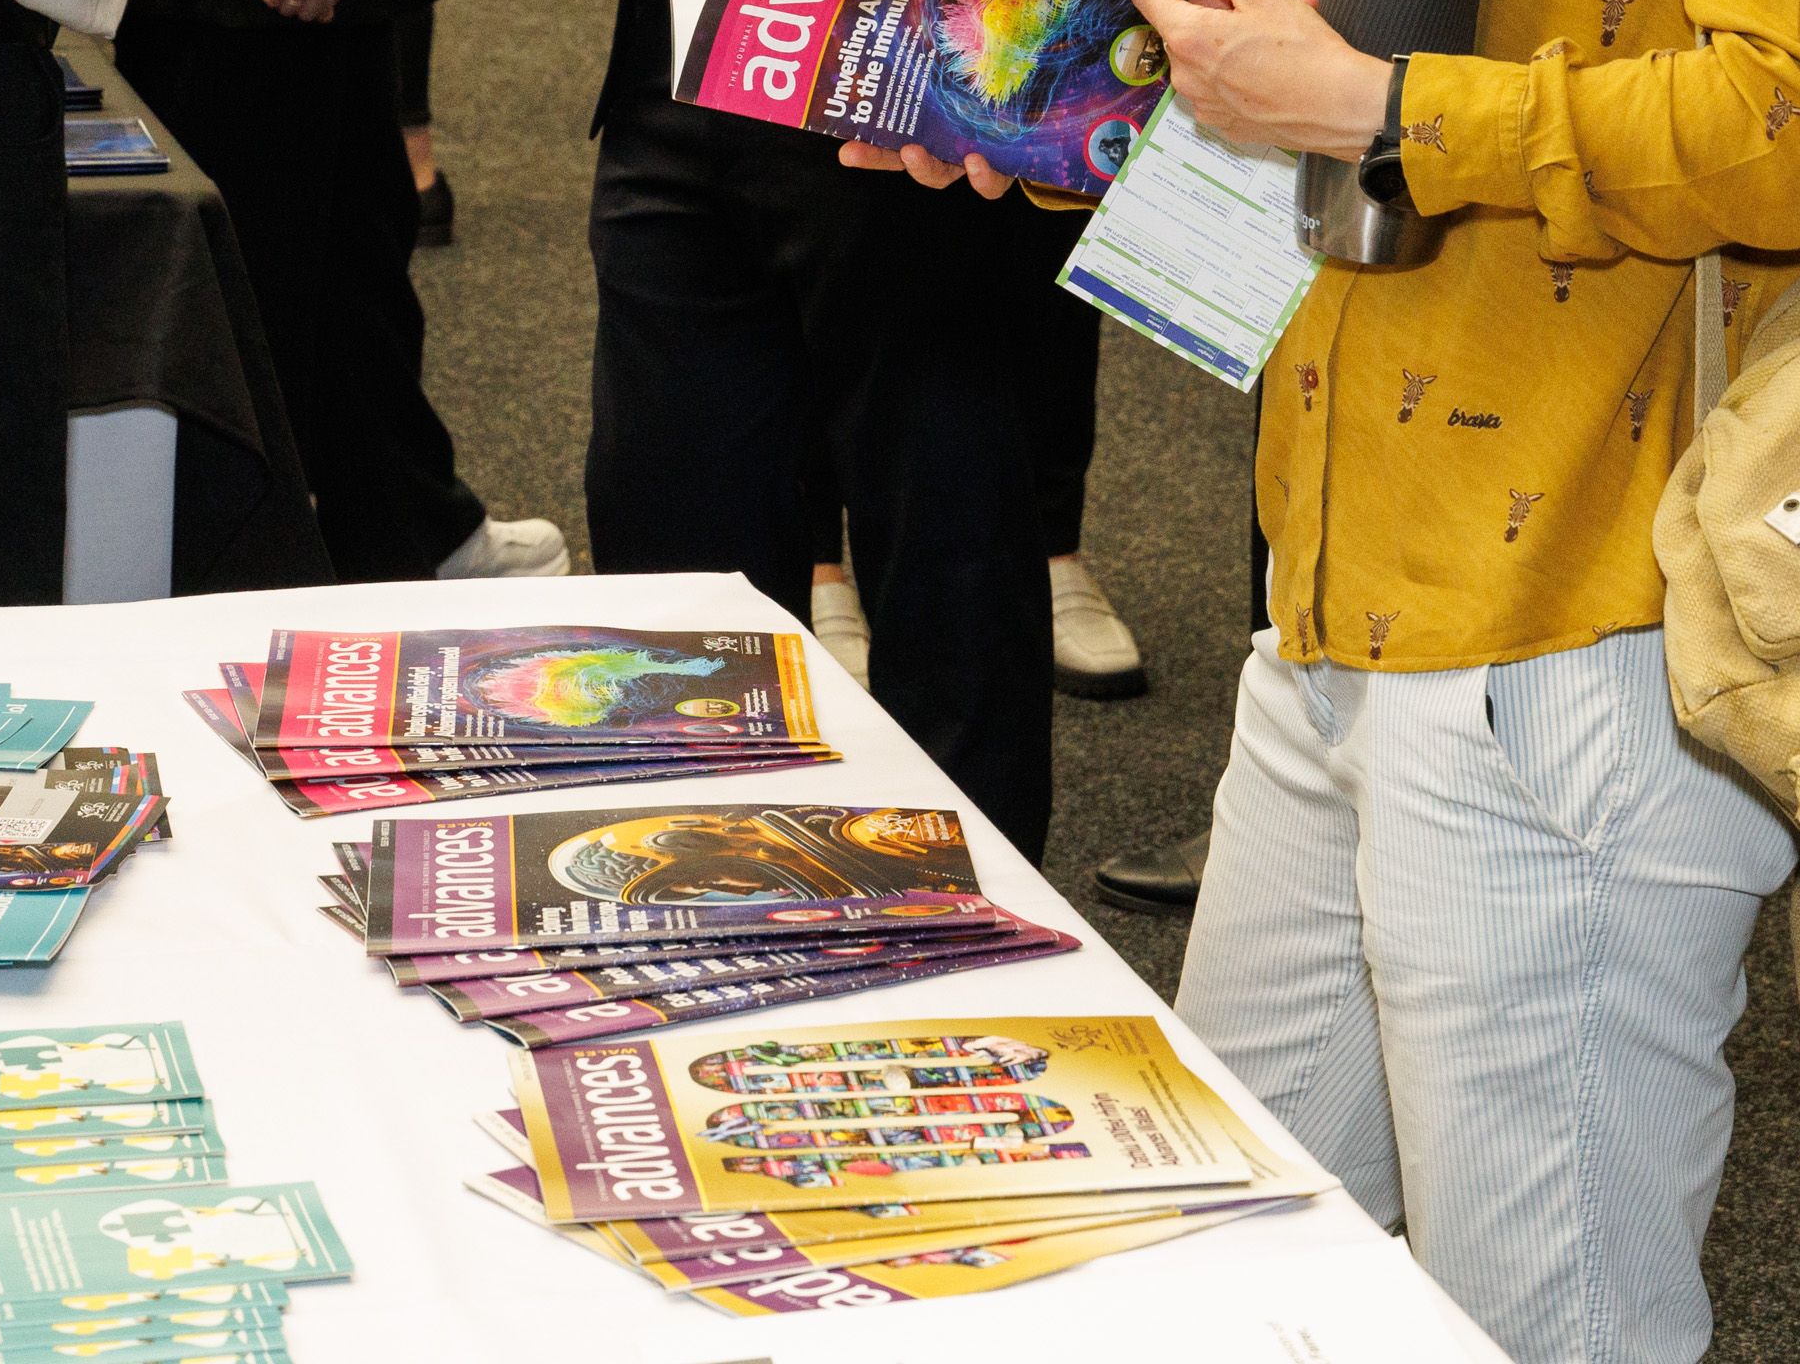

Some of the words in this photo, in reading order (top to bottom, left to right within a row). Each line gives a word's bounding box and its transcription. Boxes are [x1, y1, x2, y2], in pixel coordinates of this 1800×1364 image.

[899, 24, 912, 47] genetic
[916, 23, 923, 33] an
[728, 69, 738, 88] THE
[736, 24, 752, 66] JOURNAL
[890, 55, 901, 75] reveal
[896, 45, 904, 56] the
[902, 38, 918, 68] contribute
[824, 15, 876, 117] Unveiling
[853, 57, 885, 100] the
[898, 67, 909, 85] could
[908, 51, 926, 86] developing
[880, 74, 896, 109] researchers
[894, 84, 904, 97] that
[903, 92, 913, 104] risk
[906, 84, 914, 93] of
[906, 100, 923, 136] Alzheimer's
[915, 77, 928, 101] disease
[923, 58, 933, 72] later
[848, 97, 874, 126] to
[875, 109, 887, 128] Welsh
[885, 97, 901, 131] differences
[895, 103, 911, 133] increased
[297, 641, 382, 737] advances
[408, 828, 496, 938] advances
[574, 1048, 638, 1057] WALES
[576, 1055, 683, 1201] advances
